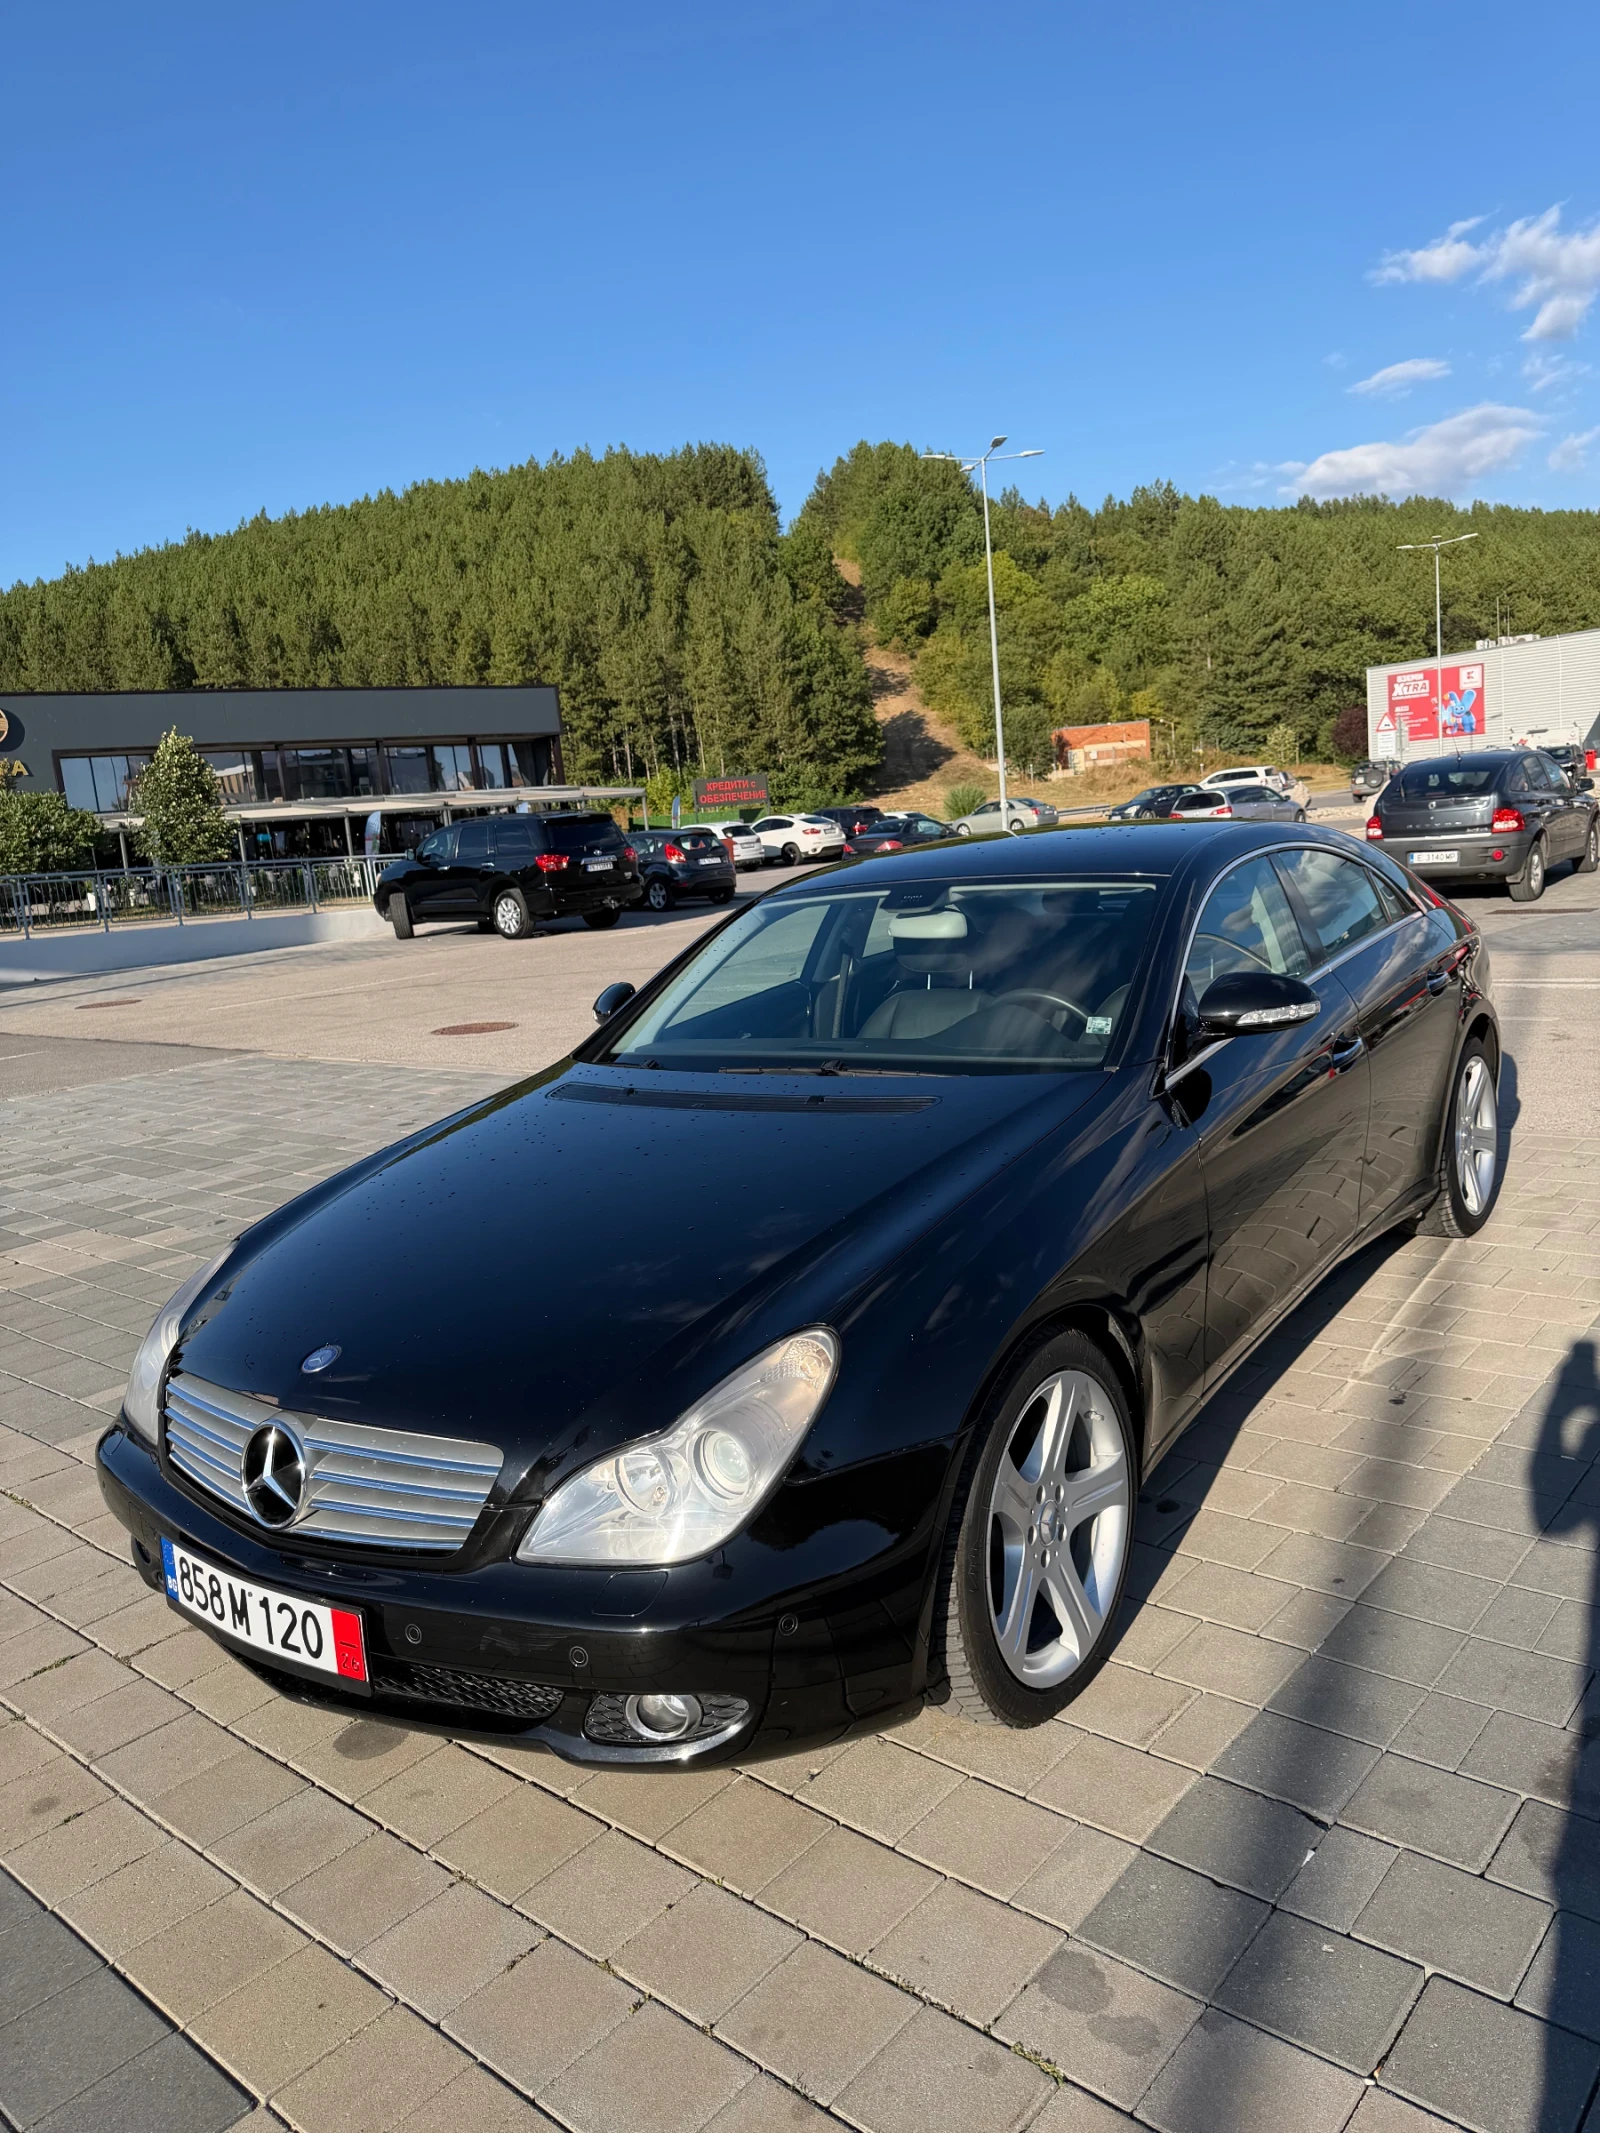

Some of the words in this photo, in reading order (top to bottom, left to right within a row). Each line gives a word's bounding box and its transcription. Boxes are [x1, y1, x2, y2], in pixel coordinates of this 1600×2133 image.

[1392, 682, 1429, 696] XTRA
[706, 779, 749, 791] КРЕДИТИ
[700, 790, 767, 804] ОБЕЗПЕЧЕНИЕ
[167, 1575, 178, 1592] BG
[179, 1556, 225, 1621] 858
[228, 1582, 251, 1636] M
[259, 1596, 323, 1659] 120
[341, 1653, 360, 1672] 26
